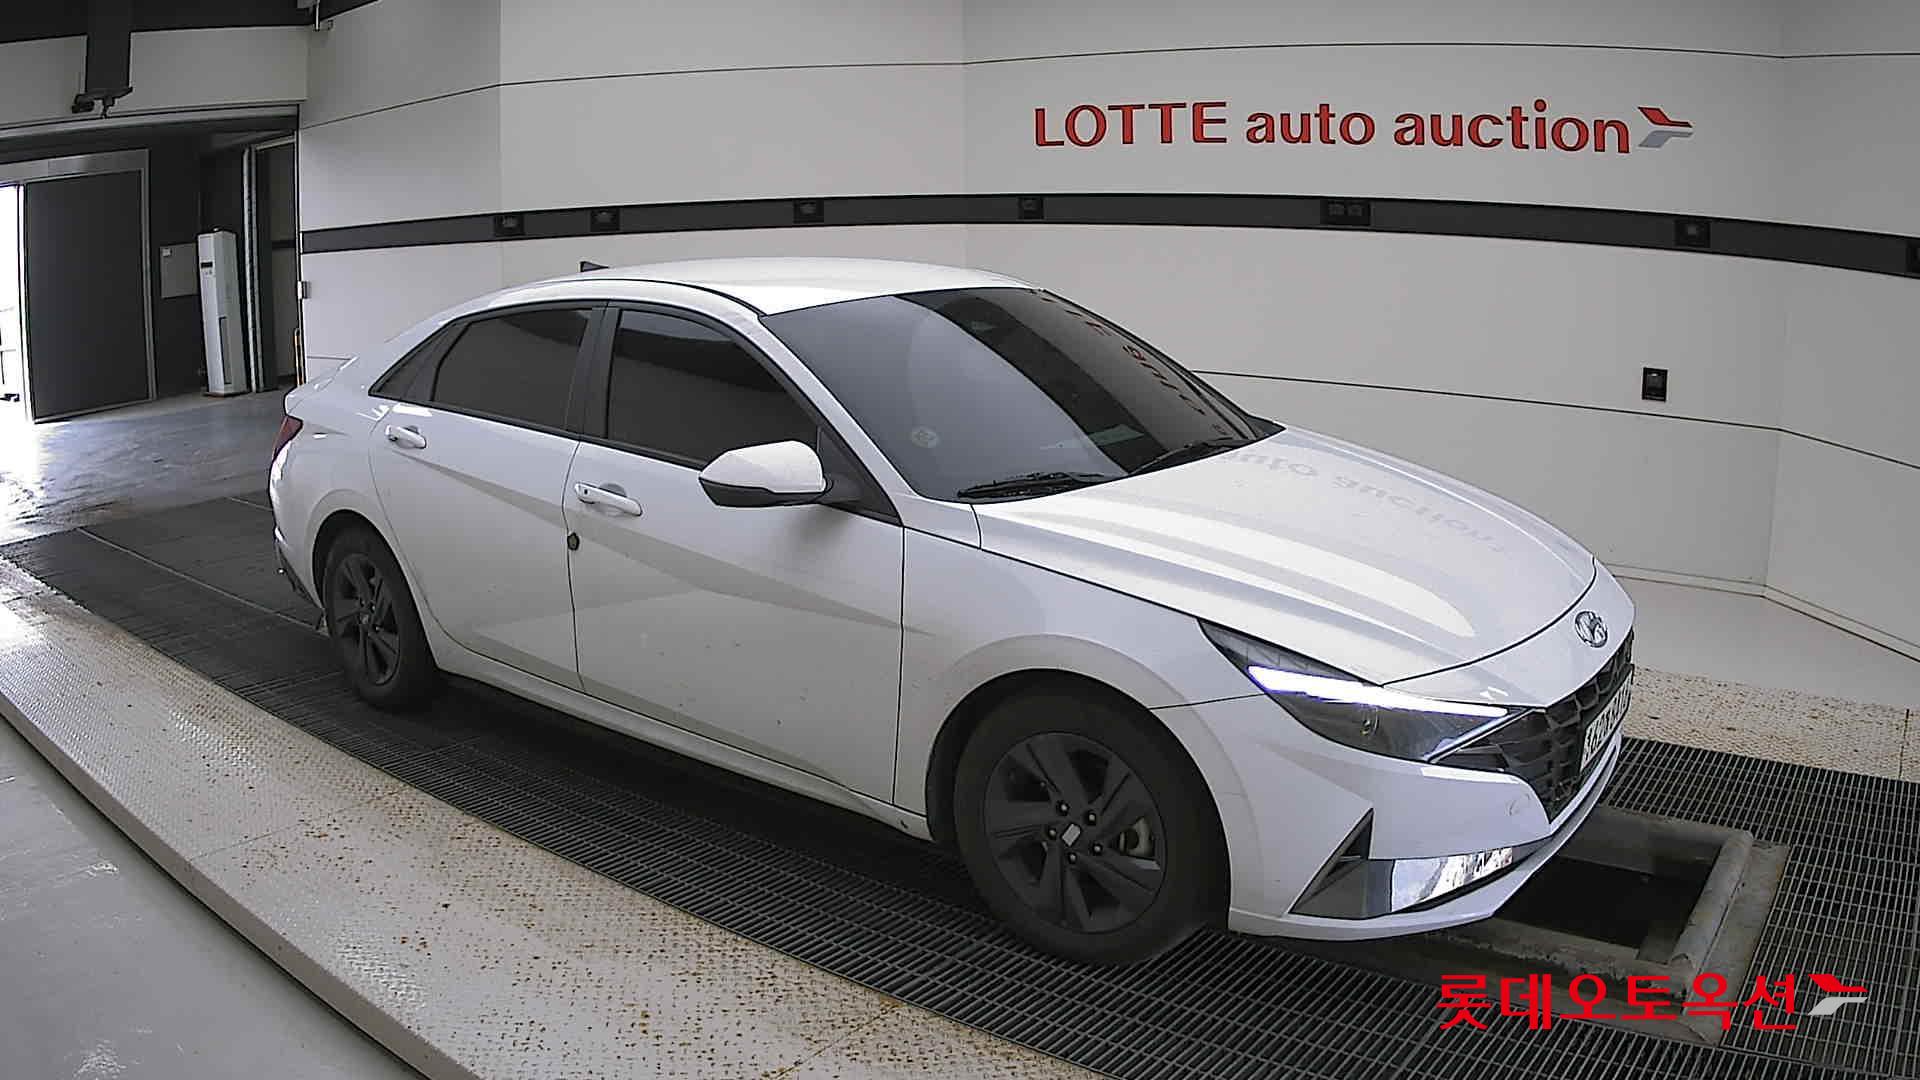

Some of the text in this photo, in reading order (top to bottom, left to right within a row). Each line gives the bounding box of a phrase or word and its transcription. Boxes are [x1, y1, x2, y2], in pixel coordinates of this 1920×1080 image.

[1034, 99, 1631, 154] LOTTE auto auction
